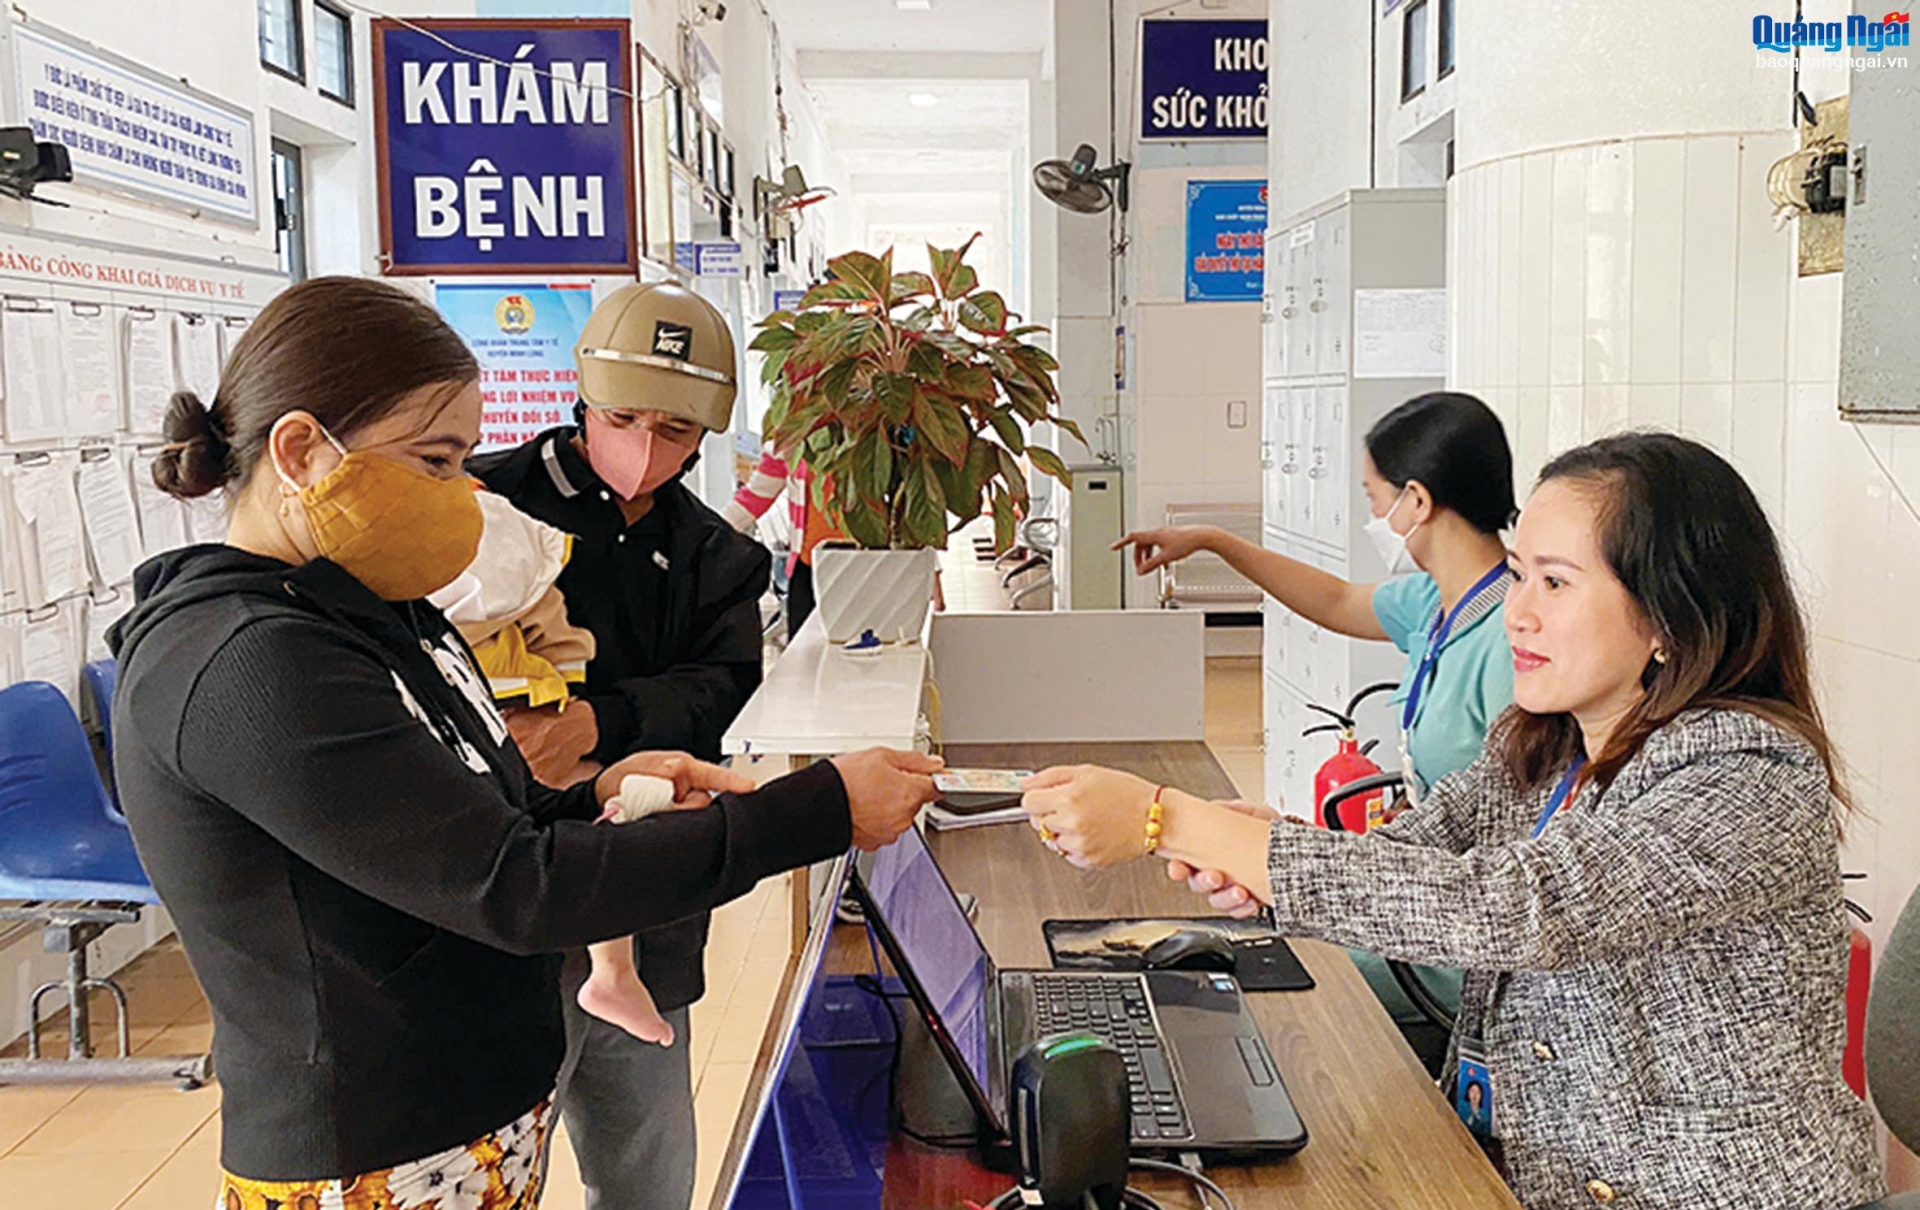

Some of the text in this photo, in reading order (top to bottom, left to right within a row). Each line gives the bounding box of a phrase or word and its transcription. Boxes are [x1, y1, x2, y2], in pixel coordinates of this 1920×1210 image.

[1215, 37, 1268, 71] KHO
[402, 44, 609, 124] KHÁM
[1152, 83, 1268, 128] SỨC KHỎ
[414, 159, 605, 251] BỆNH
[47, 254, 93, 279] CÔNG
[97, 265, 133, 285] KHAI
[137, 267, 162, 288] GIÁ
[165, 275, 196, 293] DỊCH
[219, 283, 227, 297] Y
[230, 280, 245, 299] TẾ
[493, 368, 517, 382] TÂM
[520, 369, 550, 383] THỰC
[521, 389, 557, 404] NHIỆM
[482, 408, 518, 423] HUYỂN
[488, 430, 517, 444] PHẦN
